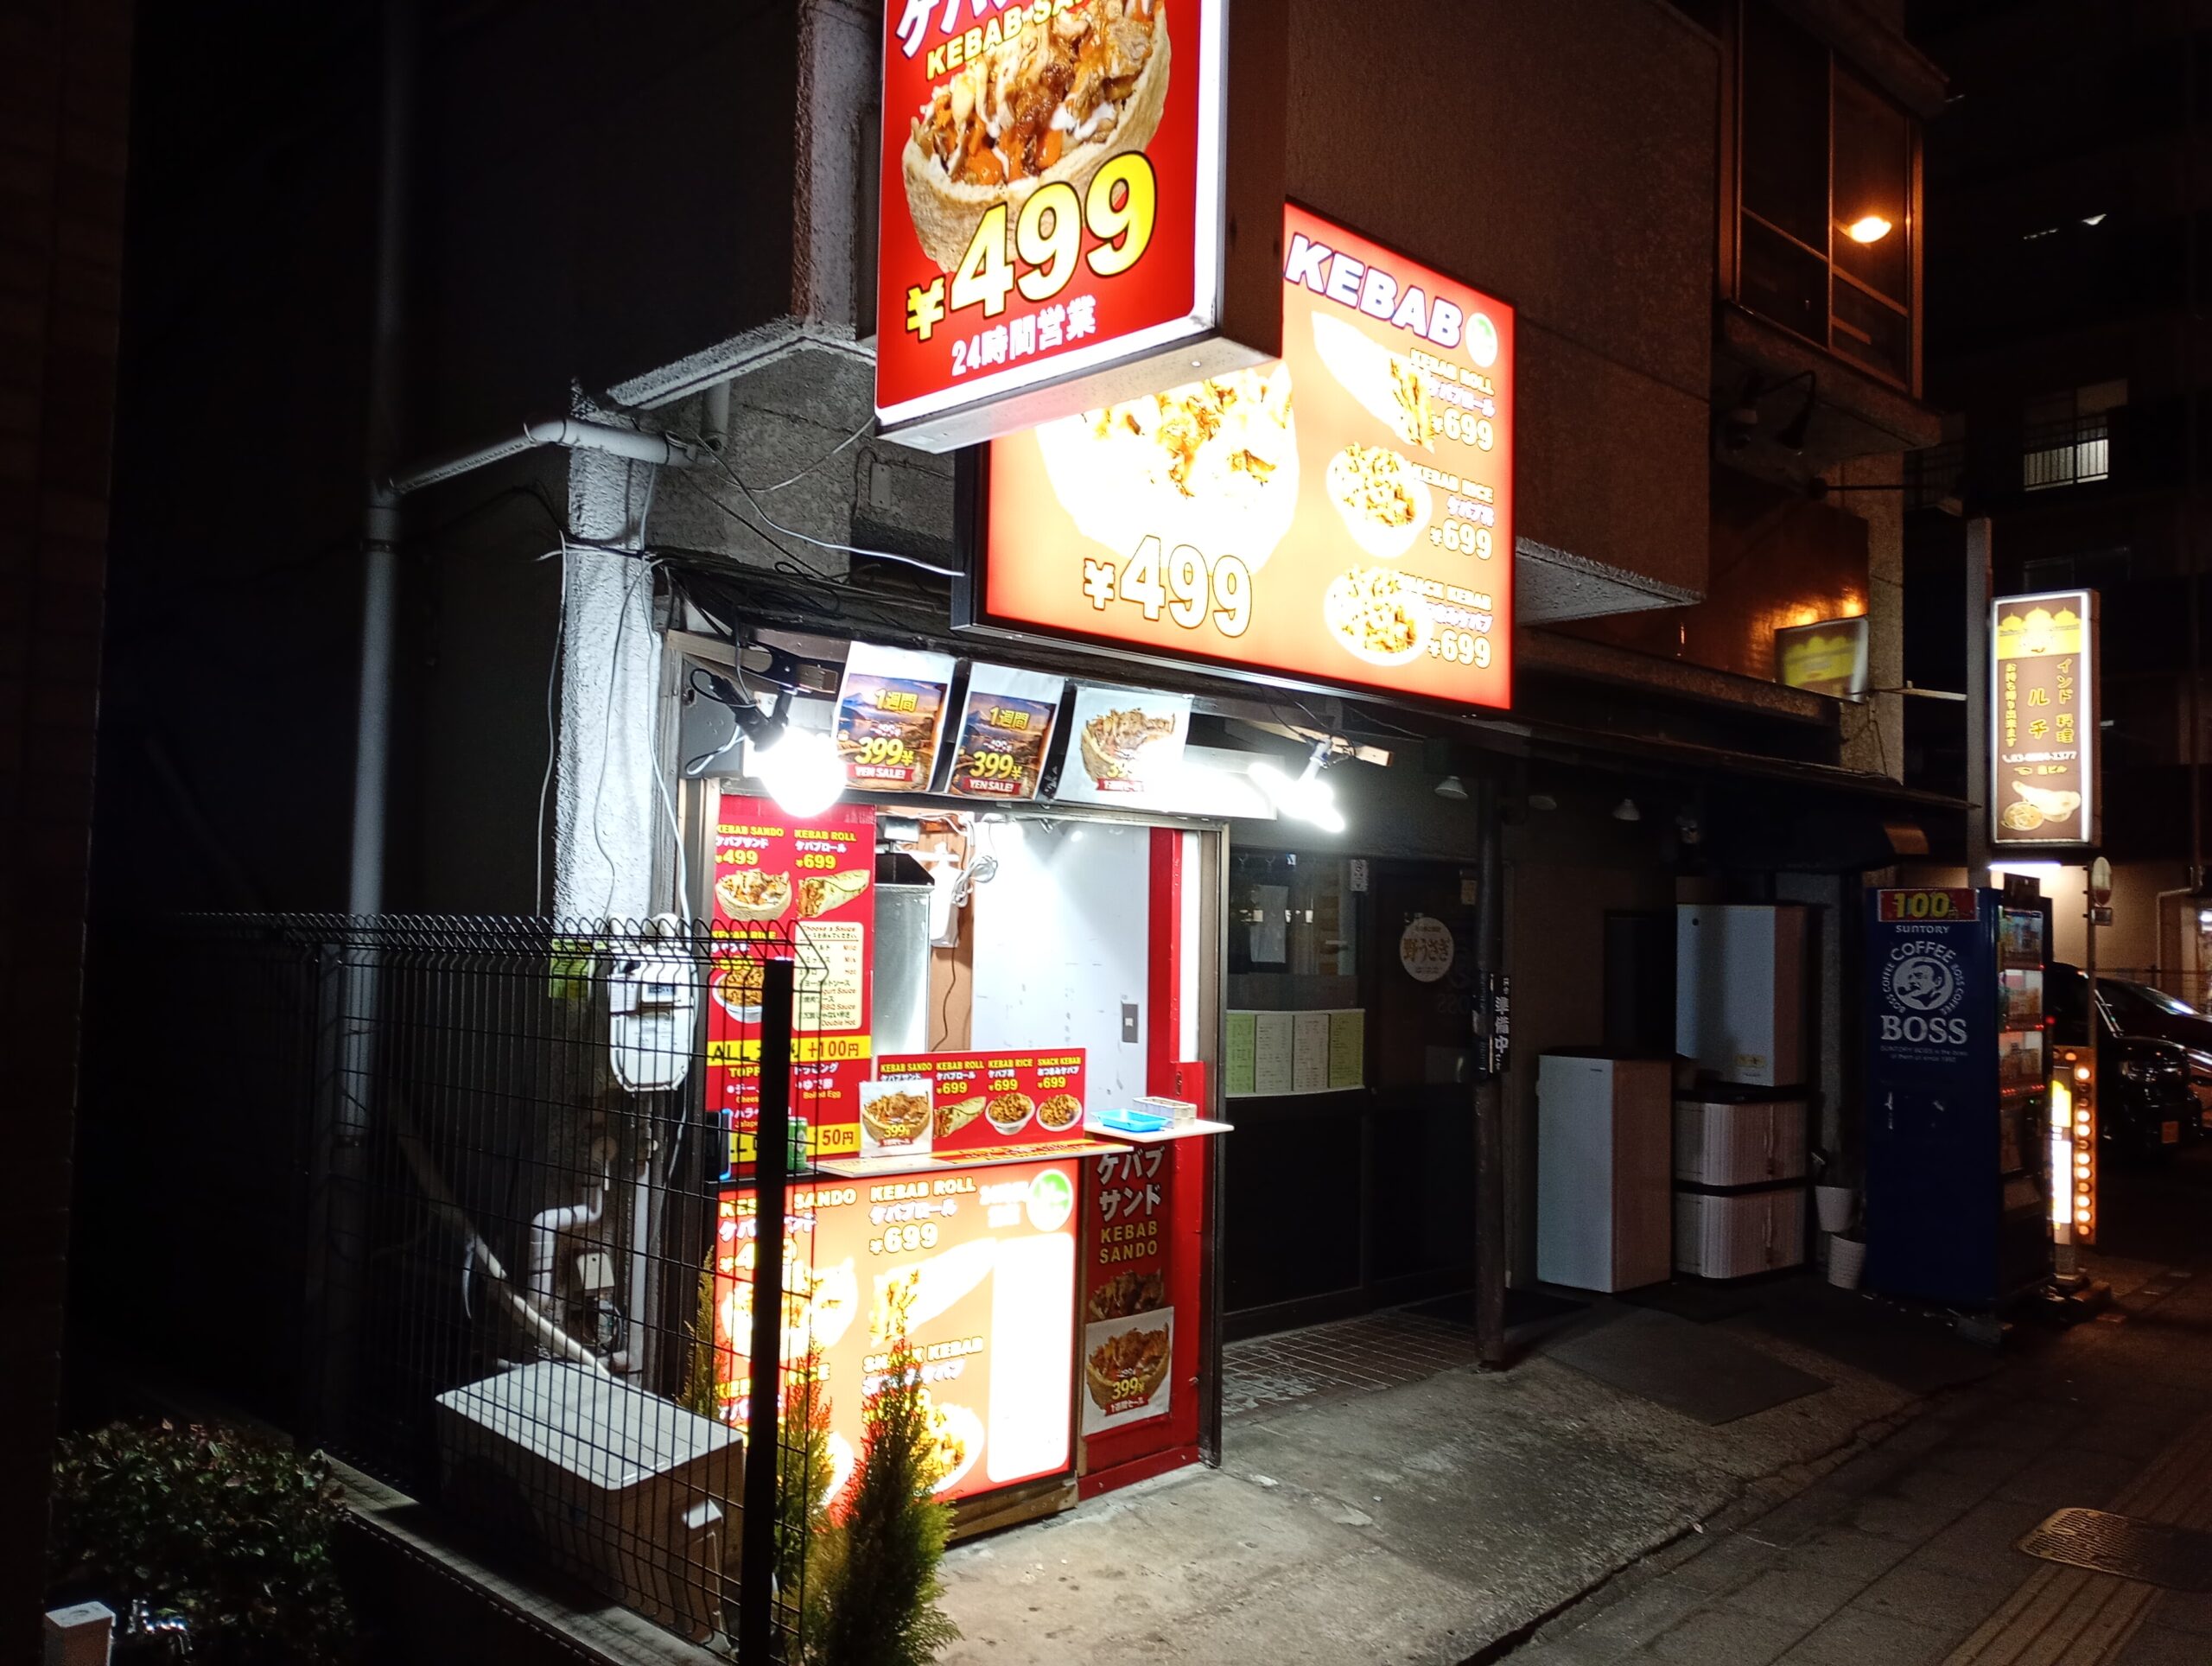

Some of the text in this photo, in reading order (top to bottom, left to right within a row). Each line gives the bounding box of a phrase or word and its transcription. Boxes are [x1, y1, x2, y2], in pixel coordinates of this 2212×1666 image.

[926, 5, 1023, 80] KEBAB
[906, 150, 1157, 341] ¥499
[1284, 232, 1463, 348] KEBAB
[951, 295, 1096, 377] 24時間営業
[1459, 367, 1495, 397] ROLL
[1431, 407, 1493, 452] ¥699
[1430, 518, 1493, 560] ¥699
[1084, 535, 1252, 638] ¥499
[1428, 629, 1491, 669] ¥699
[874, 688, 918, 713] 1週間
[2056, 658, 2075, 744] インド 料理
[989, 706, 1030, 730] 1週間
[855, 736, 914, 766] 399¥
[969, 751, 1022, 780] 399¥
[969, 779, 988, 790] YEN
[716, 824, 785, 836] KEBAB SANDO
[794, 830, 856, 842] KEBAB ROLL
[796, 854, 836, 868] ¥699
[1891, 940, 1957, 964] COFFEE
[1880, 1014, 1968, 1045] BOSS
[880, 1062, 932, 1073] KEBAB SANDO
[936, 1060, 984, 1071] KEBAB ROLL
[988, 1059, 1033, 1068] KEBAB RICE
[1037, 1058, 1058, 1066] SNACK
[936, 1082, 968, 1095] ¥699
[988, 1078, 1018, 1091] ¥699
[1037, 1077, 1066, 1089] ¥699
[1096, 1146, 1166, 1185] ケバブ
[794, 1188, 857, 1210] SANDO
[870, 1181, 930, 1203] KEBAB
[933, 1176, 977, 1197] ROLL
[868, 1198, 958, 1225] ケバブロール
[1097, 1183, 1162, 1223] サンド
[869, 1222, 938, 1255] ¥699
[1101, 1220, 1159, 1244] KEBAB
[1099, 1239, 1158, 1264] SANDO
[927, 1336, 983, 1362] KEBAB
[1111, 1377, 1145, 1400] 399¥
